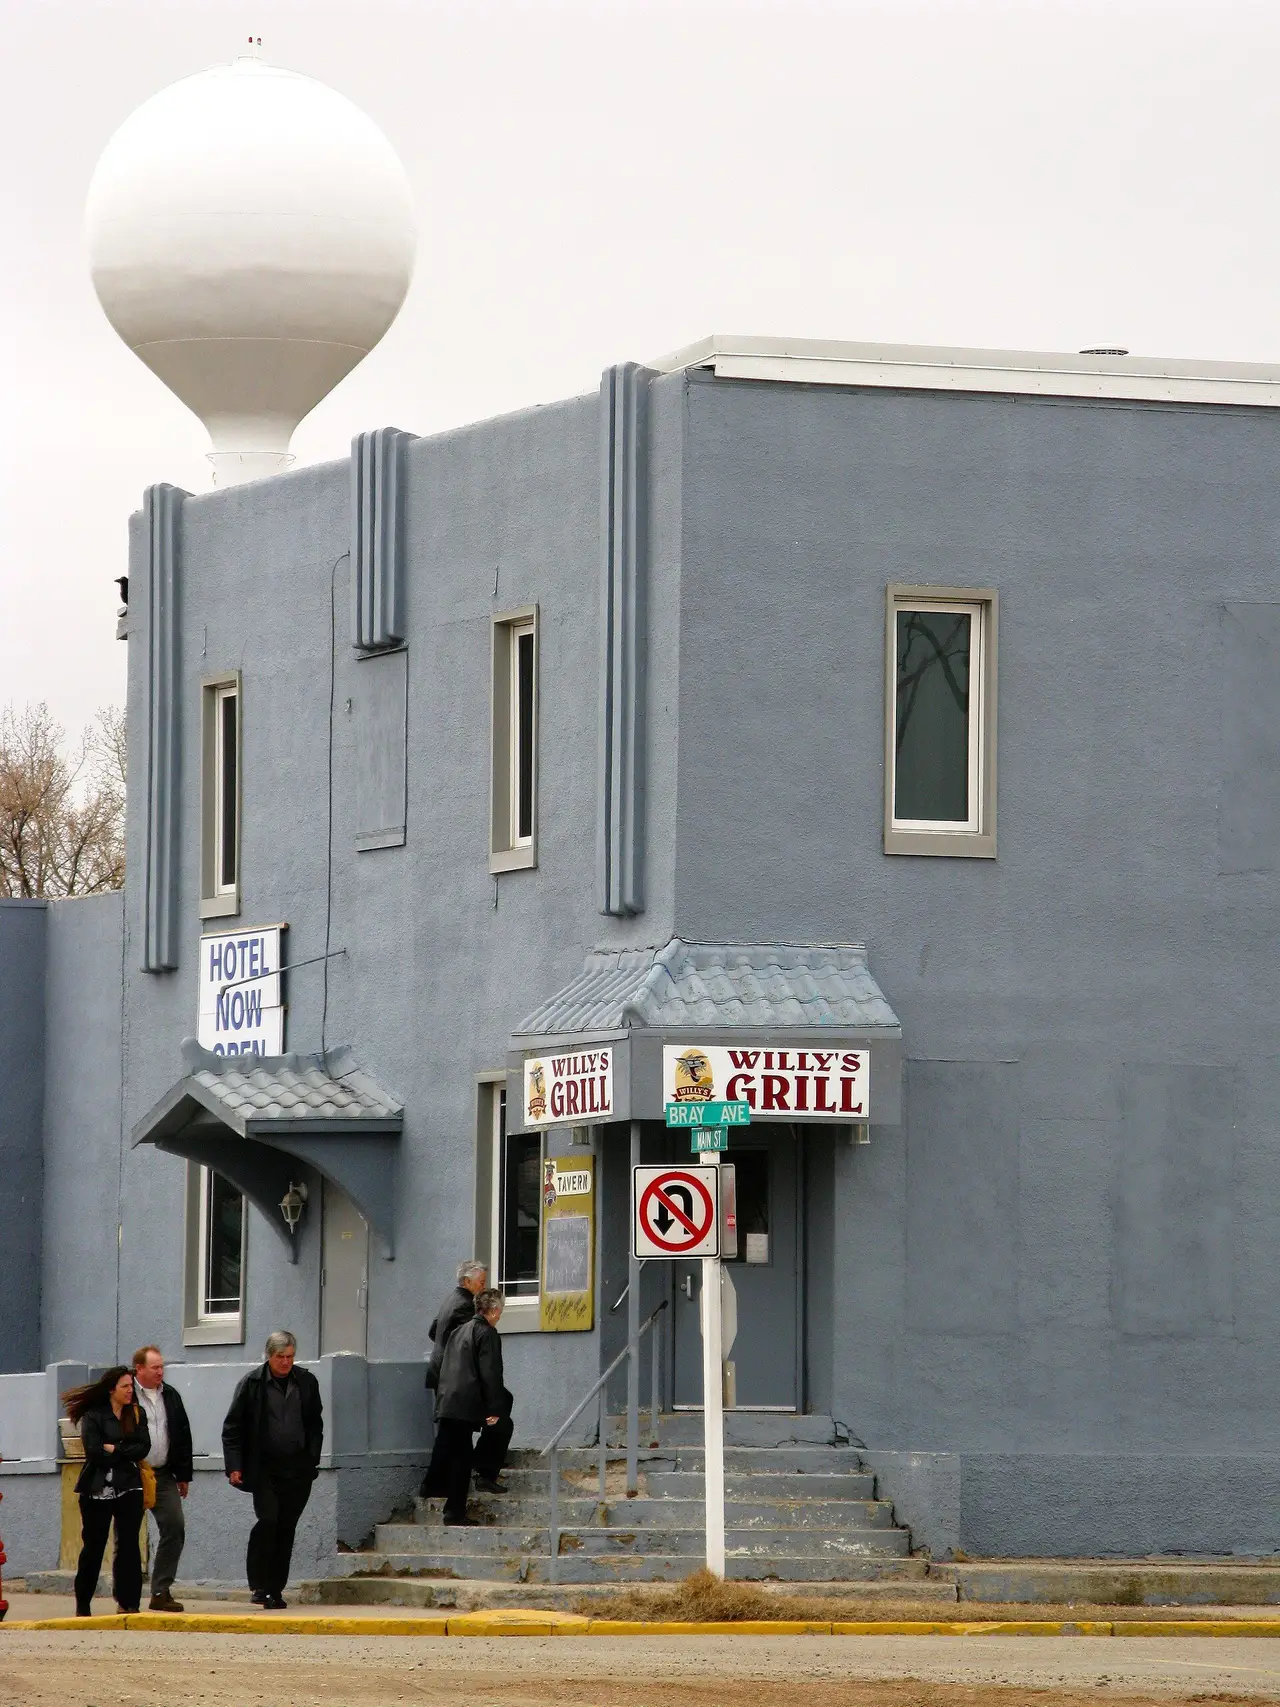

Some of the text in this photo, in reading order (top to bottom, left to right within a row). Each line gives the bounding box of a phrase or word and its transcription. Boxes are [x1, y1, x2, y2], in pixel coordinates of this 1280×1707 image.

[210, 938, 269, 982] HOTEL
[216, 989, 262, 1031] NOW
[551, 1052, 609, 1077] WILLY'S
[727, 1051, 861, 1073] WILLY'S
[551, 1076, 610, 1117] GRILL
[679, 1087, 709, 1096] WILLY'S
[726, 1074, 863, 1114] GRILL
[669, 1105, 746, 1124] BRAY AVE
[697, 1130, 722, 1149] MAIN ST
[557, 1174, 588, 1192] TAVERN
